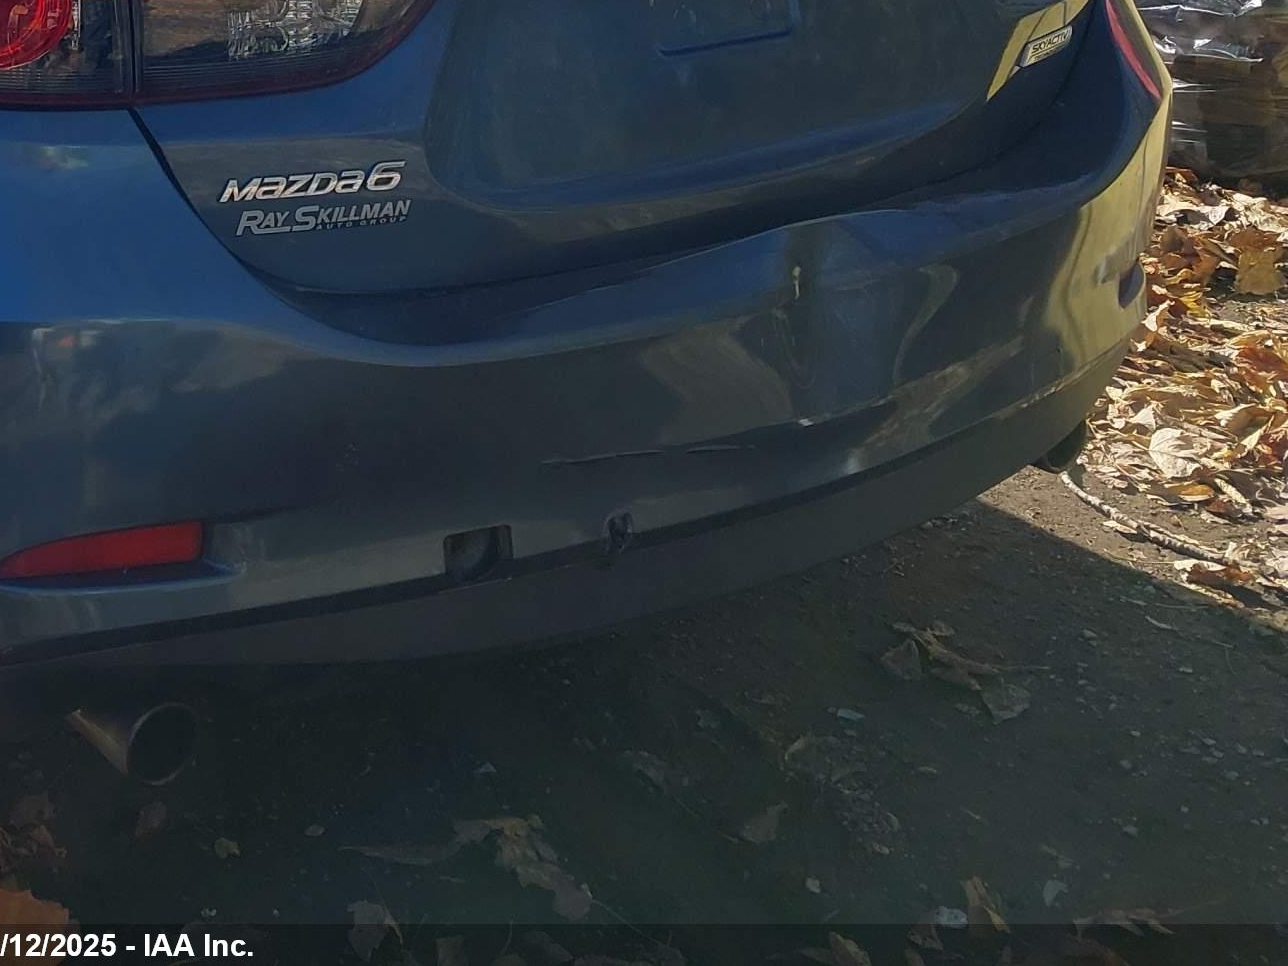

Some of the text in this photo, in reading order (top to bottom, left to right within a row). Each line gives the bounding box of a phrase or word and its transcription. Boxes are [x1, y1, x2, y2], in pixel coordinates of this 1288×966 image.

[236, 199, 411, 235] RAY SKILLMAN
[316, 215, 407, 231] AUTO GROUP
